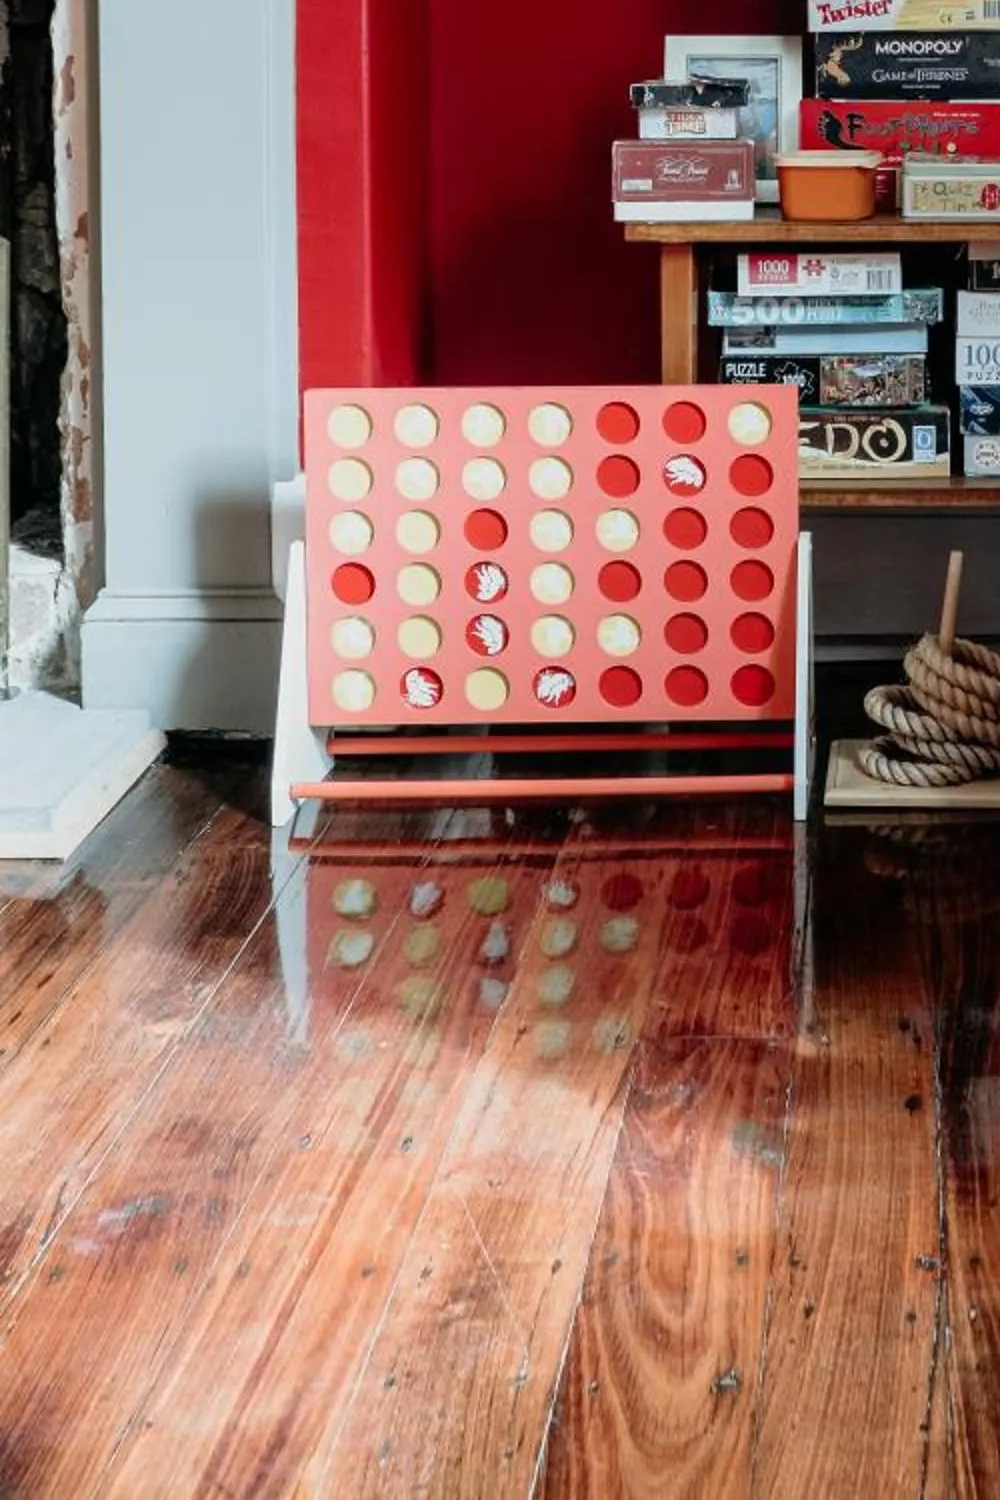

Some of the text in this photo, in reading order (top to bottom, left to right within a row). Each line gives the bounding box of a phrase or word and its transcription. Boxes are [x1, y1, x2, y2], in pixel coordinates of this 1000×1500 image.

[875, 40, 962, 55] MONOPOLY
[872, 68, 906, 83] GAME
[914, 67, 968, 81] THRONES
[757, 259, 789, 274] 1000
[731, 297, 805, 322] 500
[725, 363, 767, 378] PUZZLE
[798, 417, 907, 462] EDO
